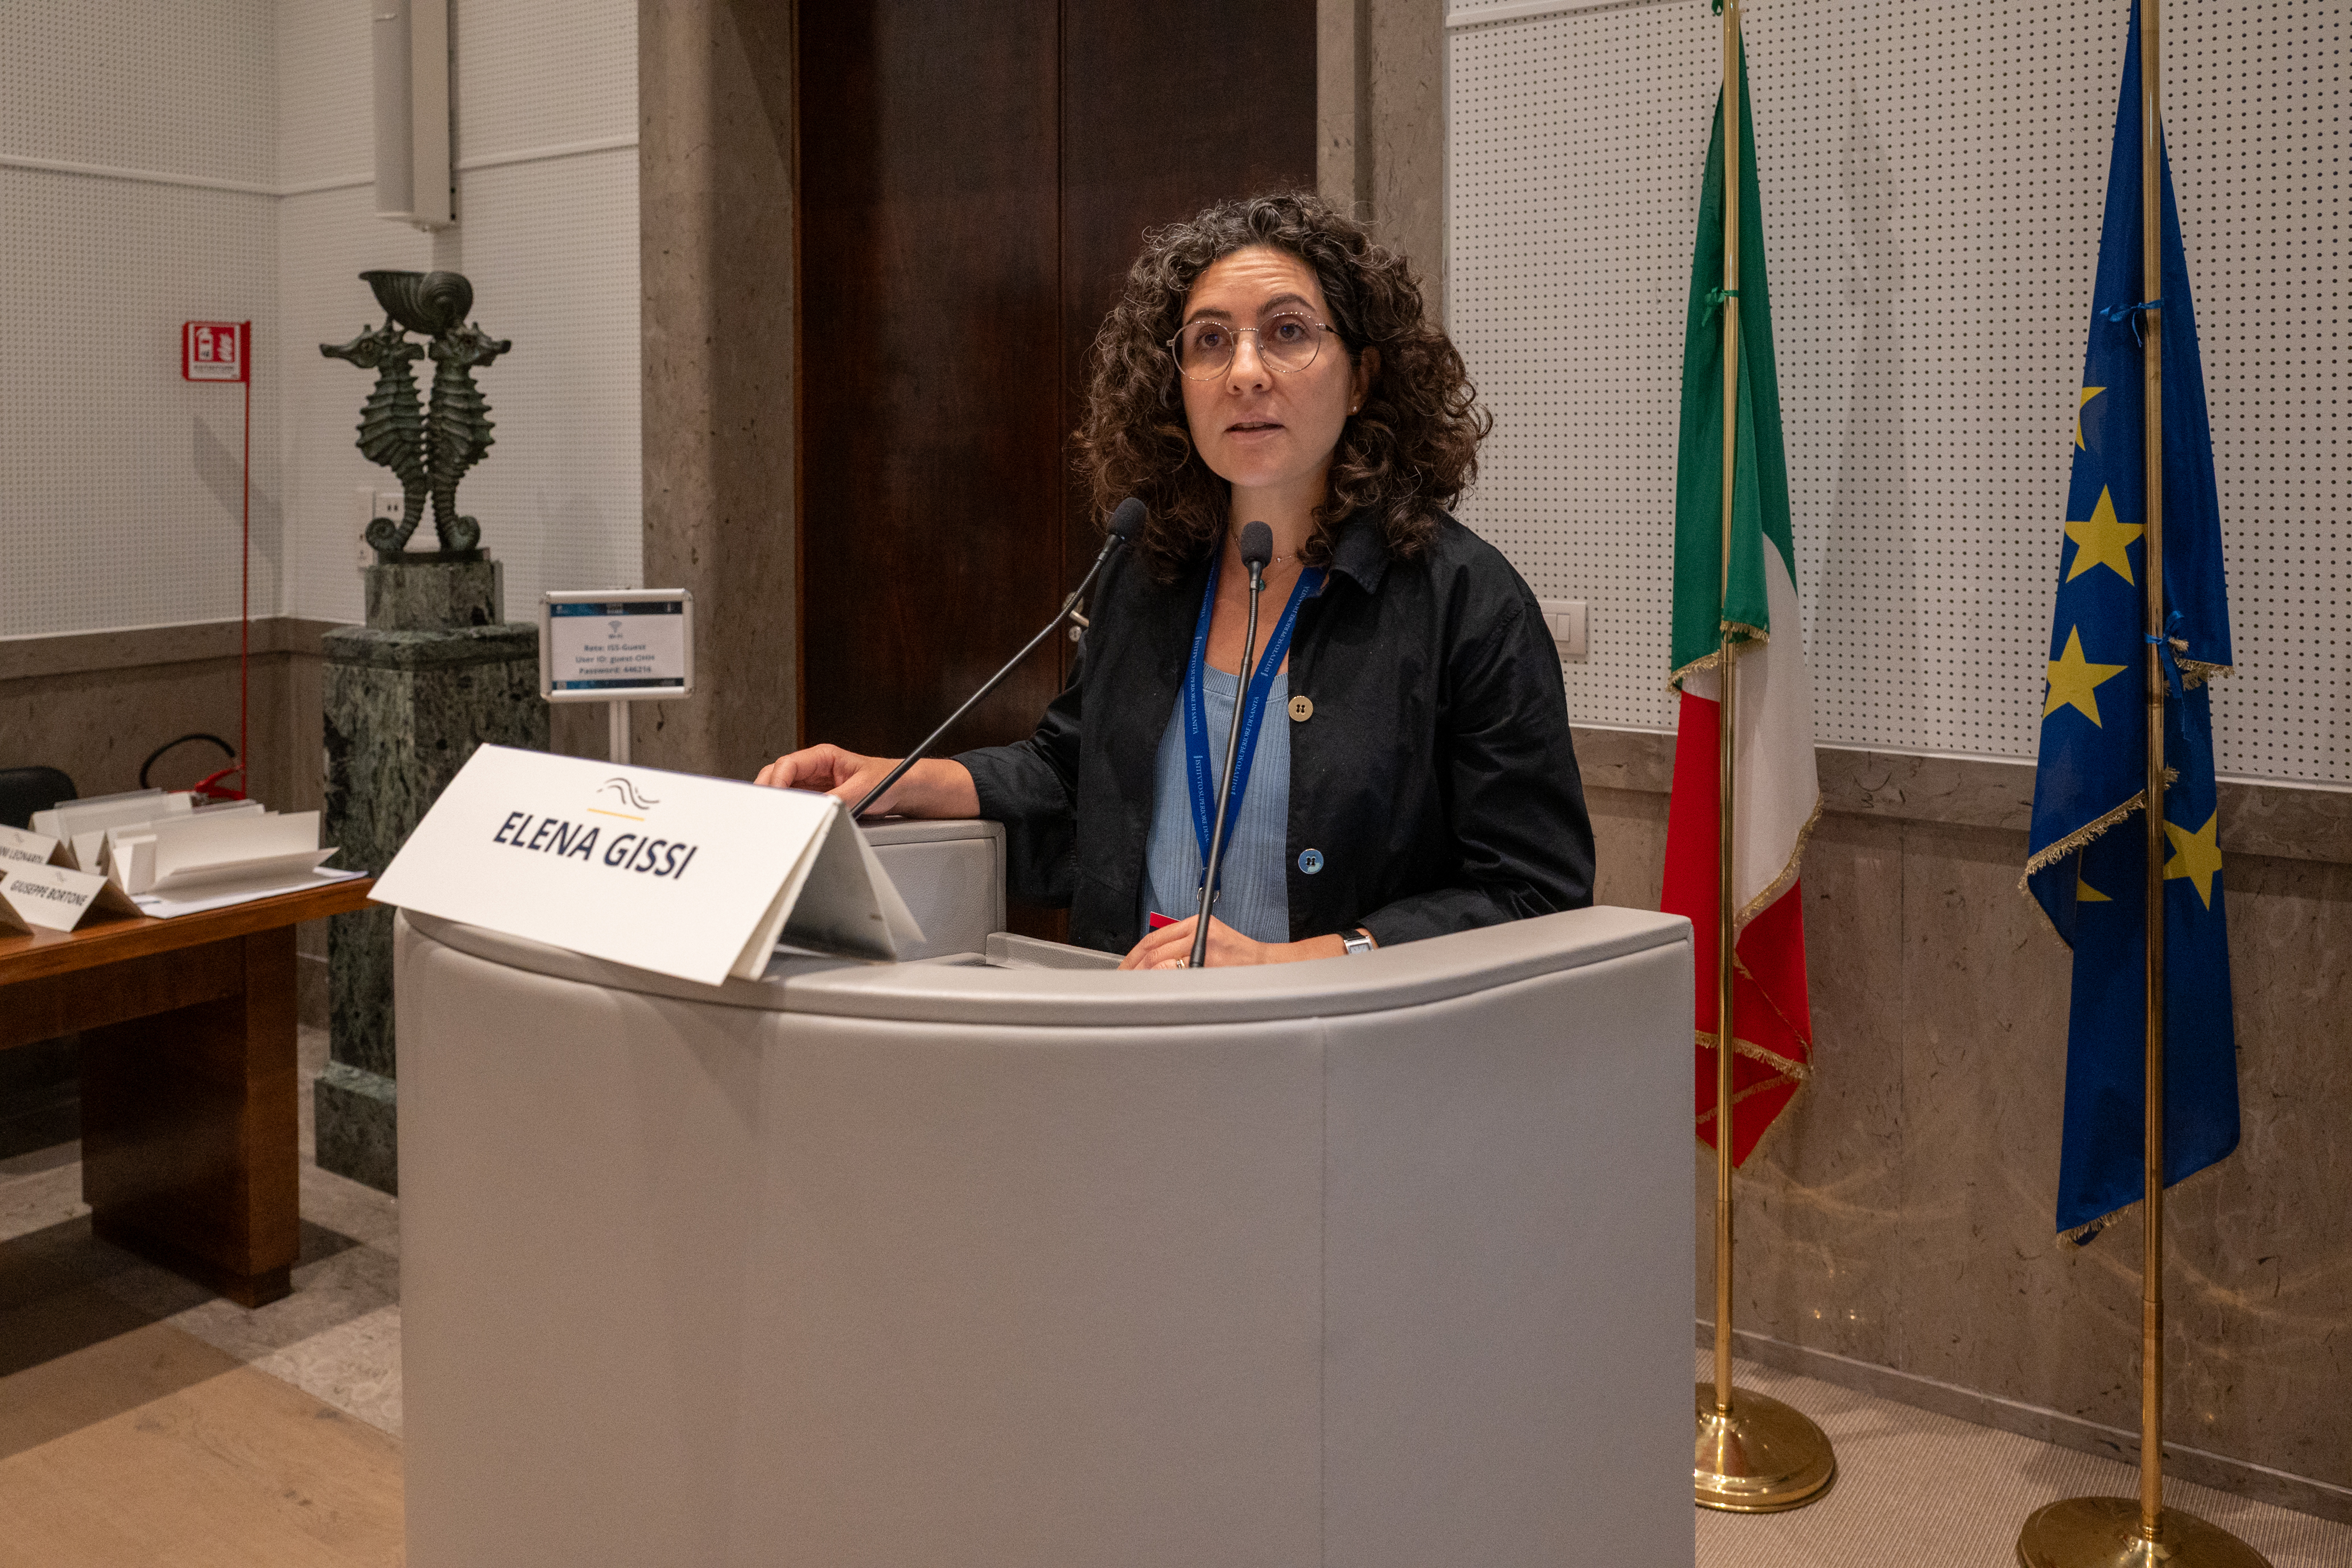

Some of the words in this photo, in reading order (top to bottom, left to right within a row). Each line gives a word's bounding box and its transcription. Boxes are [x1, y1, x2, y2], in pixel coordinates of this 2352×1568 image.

[1278, 613, 1296, 645] SUPERIORE
[1292, 605, 1299, 614] DI
[1239, 727, 1251, 761] SUPERIORE
[1198, 790, 1207, 825] SUPERIORE
[493, 811, 601, 861] ELENA
[603, 833, 698, 880] GISSI
[10, 880, 49, 898] GIUSEPPE
[47, 888, 88, 906] BORTONE
